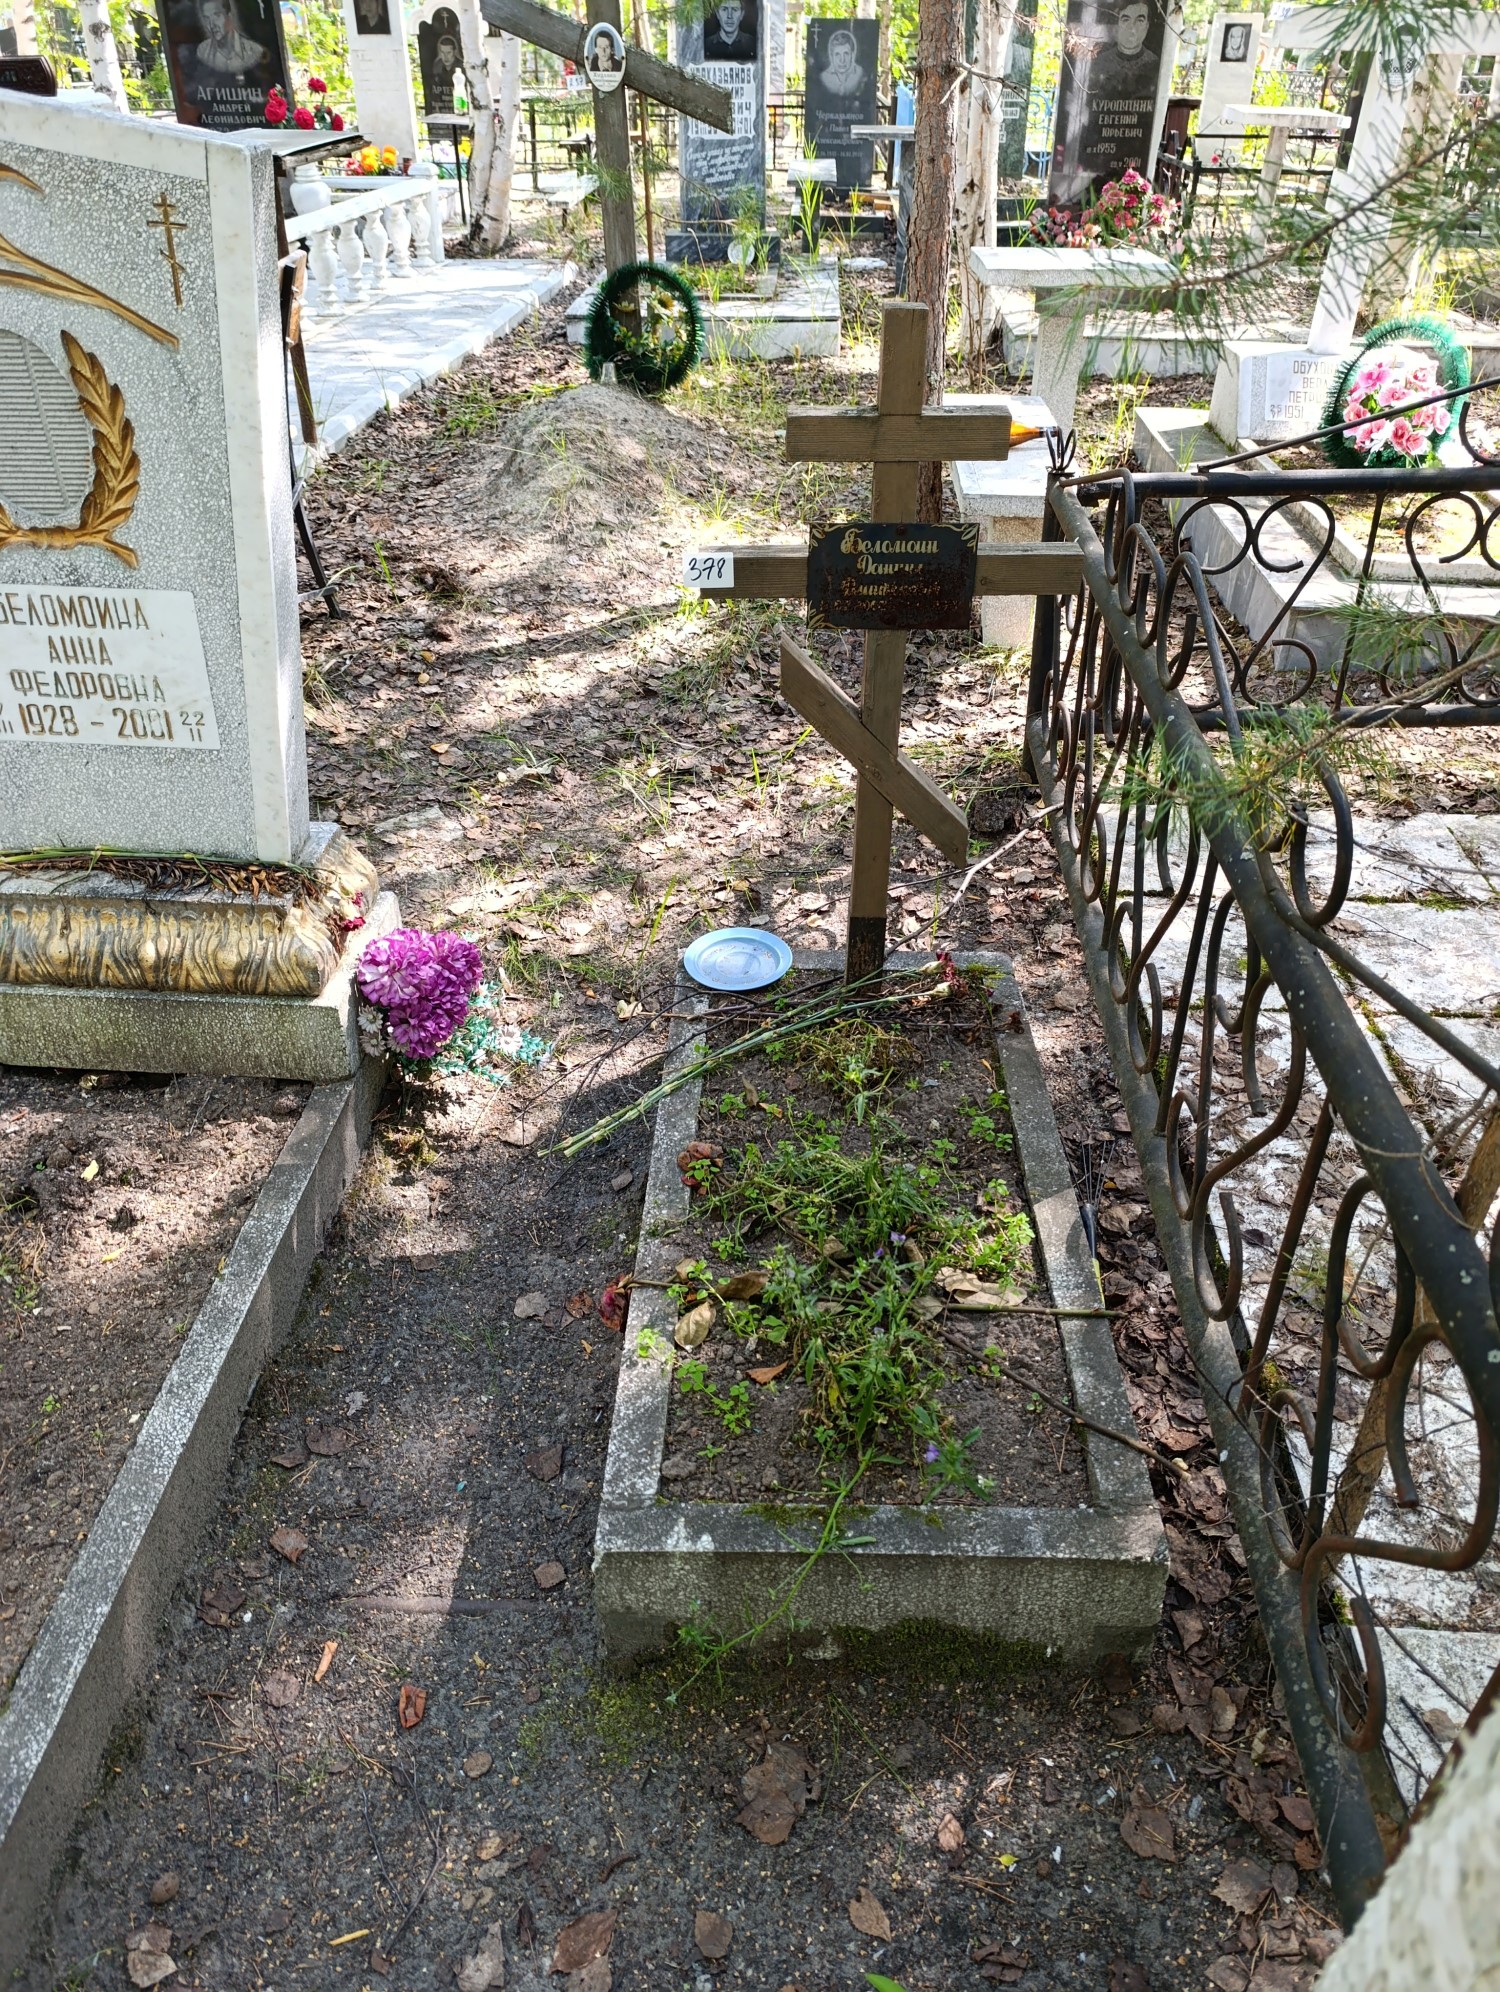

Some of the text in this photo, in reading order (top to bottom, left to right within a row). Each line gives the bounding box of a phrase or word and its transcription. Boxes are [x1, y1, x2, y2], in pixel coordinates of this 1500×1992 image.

[197, 85, 263, 102] АГИШИН
[1092, 99, 1153, 112] КУРОПЯТНИК
[1099, 113, 1138, 125] ЕВГЕНИЙ
[1102, 127, 1143, 138] ЮРЬЕВИЧ
[840, 528, 940, 555] Беломоин
[687, 557, 726, 581] 378
[48, 635, 113, 665] АННА
[9, 668, 166, 702] ФЕДОРОВНА
[18, 703, 79, 737] 1928
[112, 707, 174, 741] 2001
